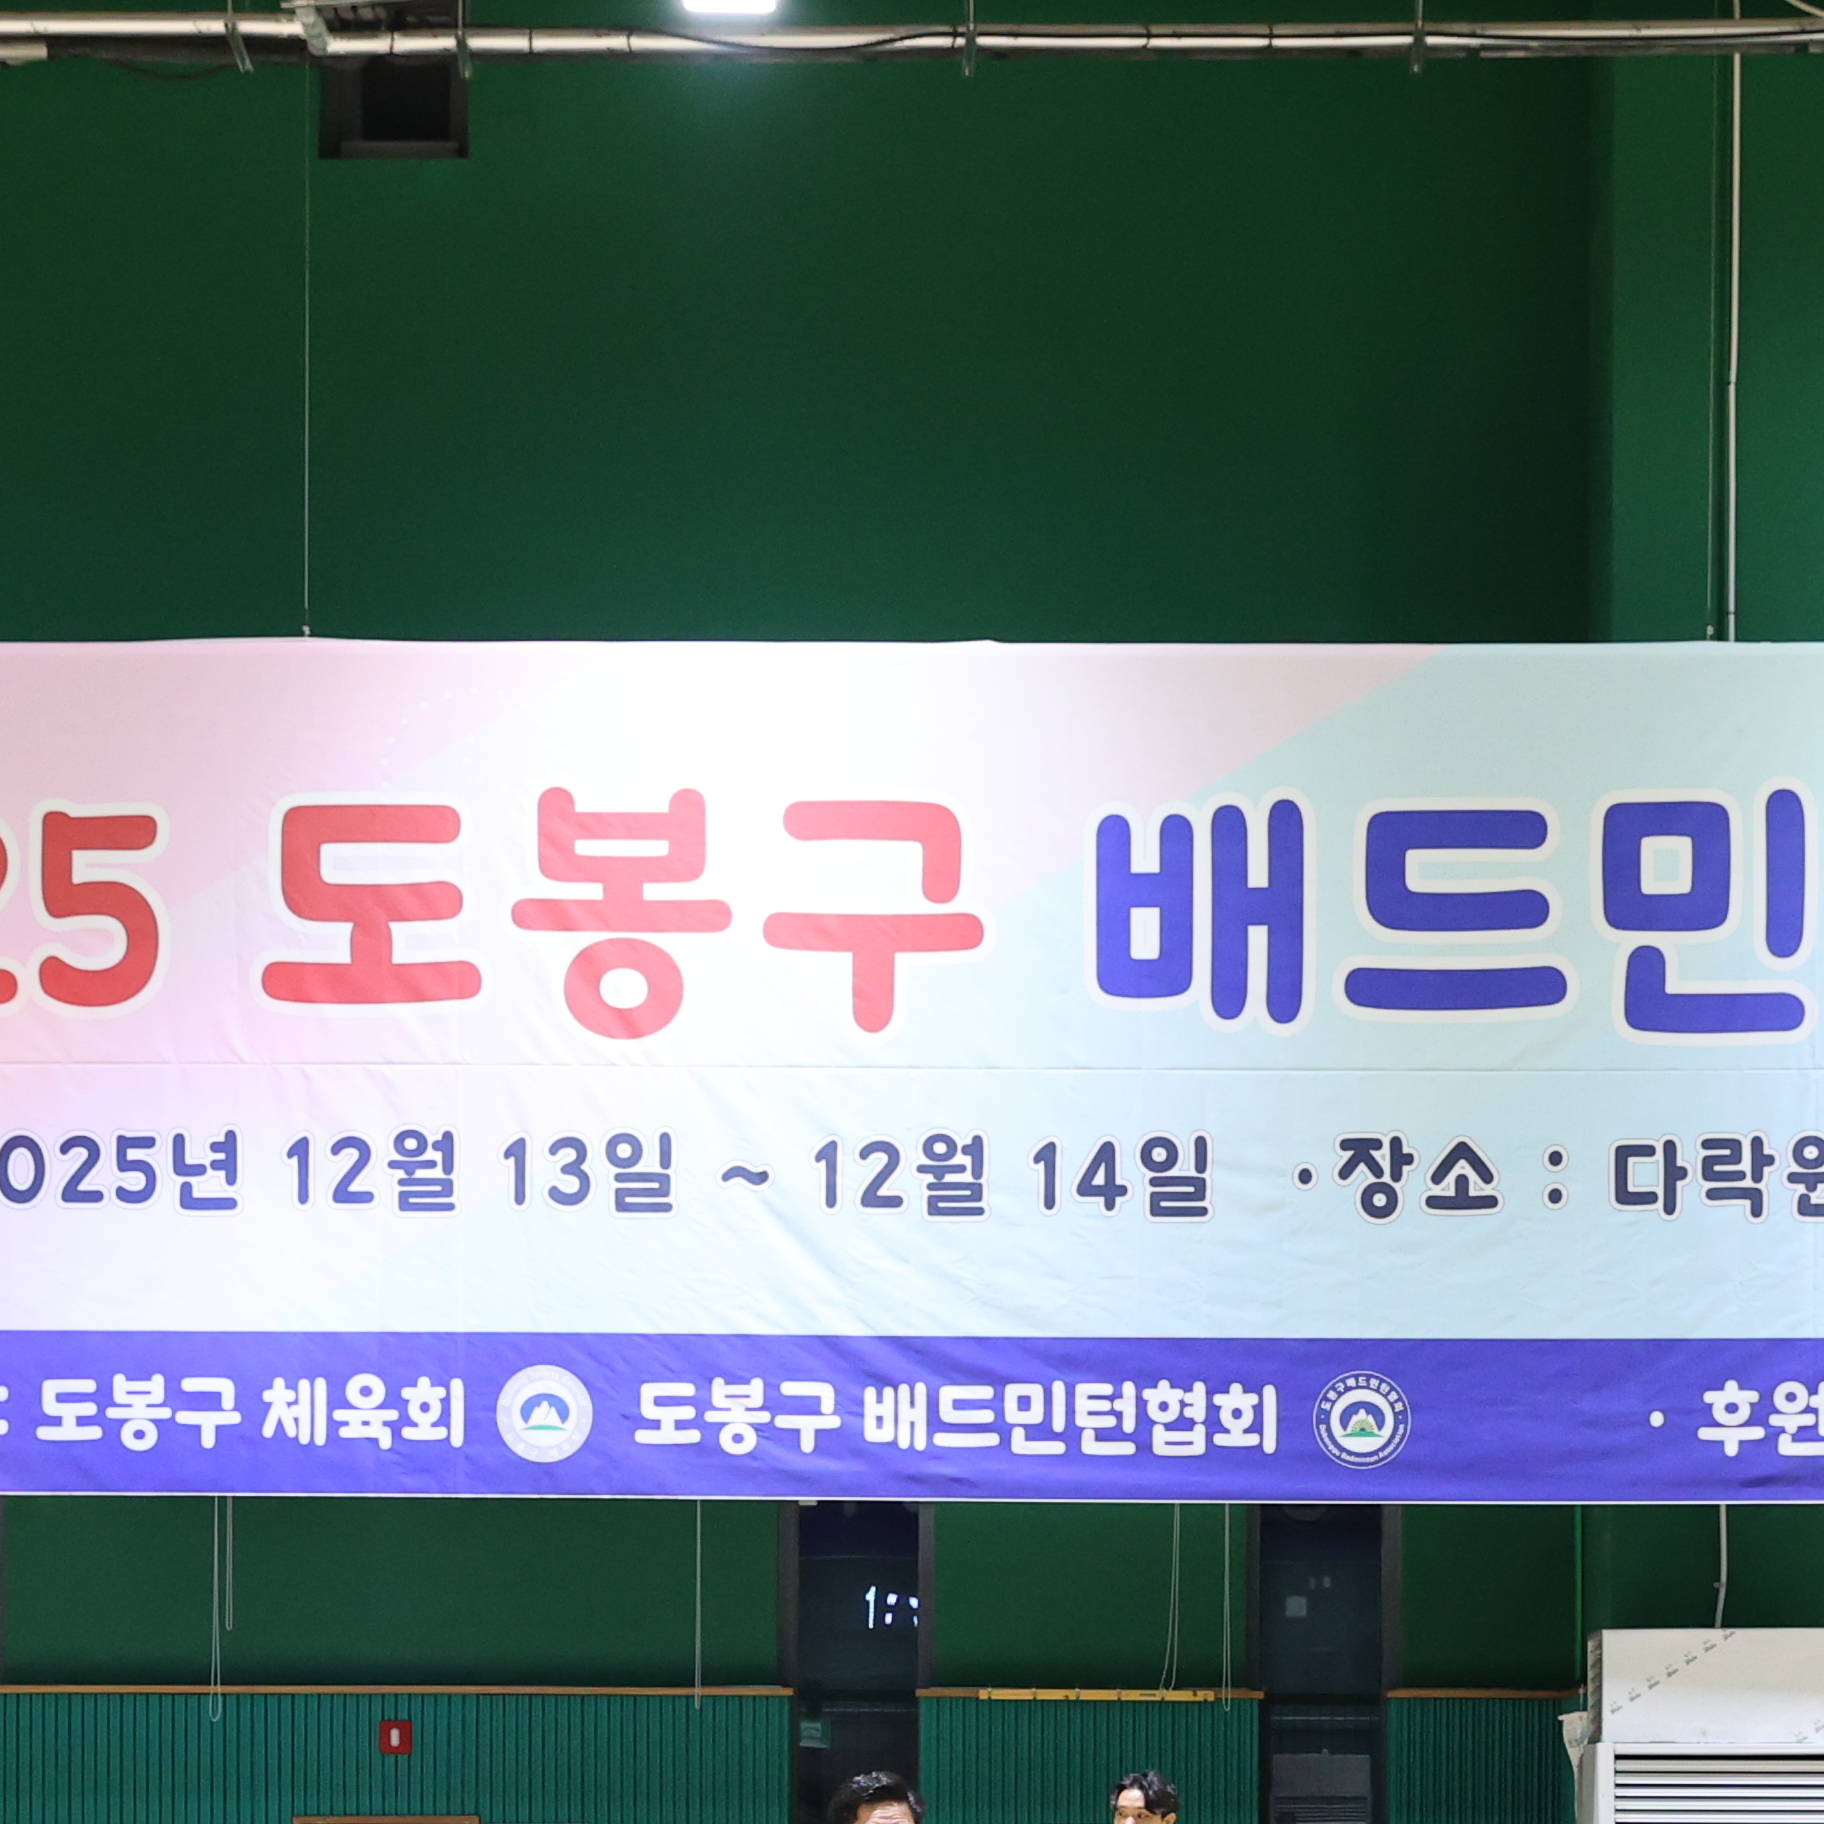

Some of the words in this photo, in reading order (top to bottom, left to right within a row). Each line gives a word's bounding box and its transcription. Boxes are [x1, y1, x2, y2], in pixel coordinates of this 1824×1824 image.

[261, 786, 986, 1040] 도봉구
[286, 1129, 456, 1212] 12월
[503, 1131, 674, 1214] 13일
[815, 1131, 985, 1216] 12월
[1033, 1131, 1208, 1217] 14일
[36, 1373, 242, 1452] 도봉구
[262, 1374, 465, 1450] 체육회
[634, 1377, 841, 1455] 도봉구
[865, 1378, 1278, 1457] 배드민턴협회
